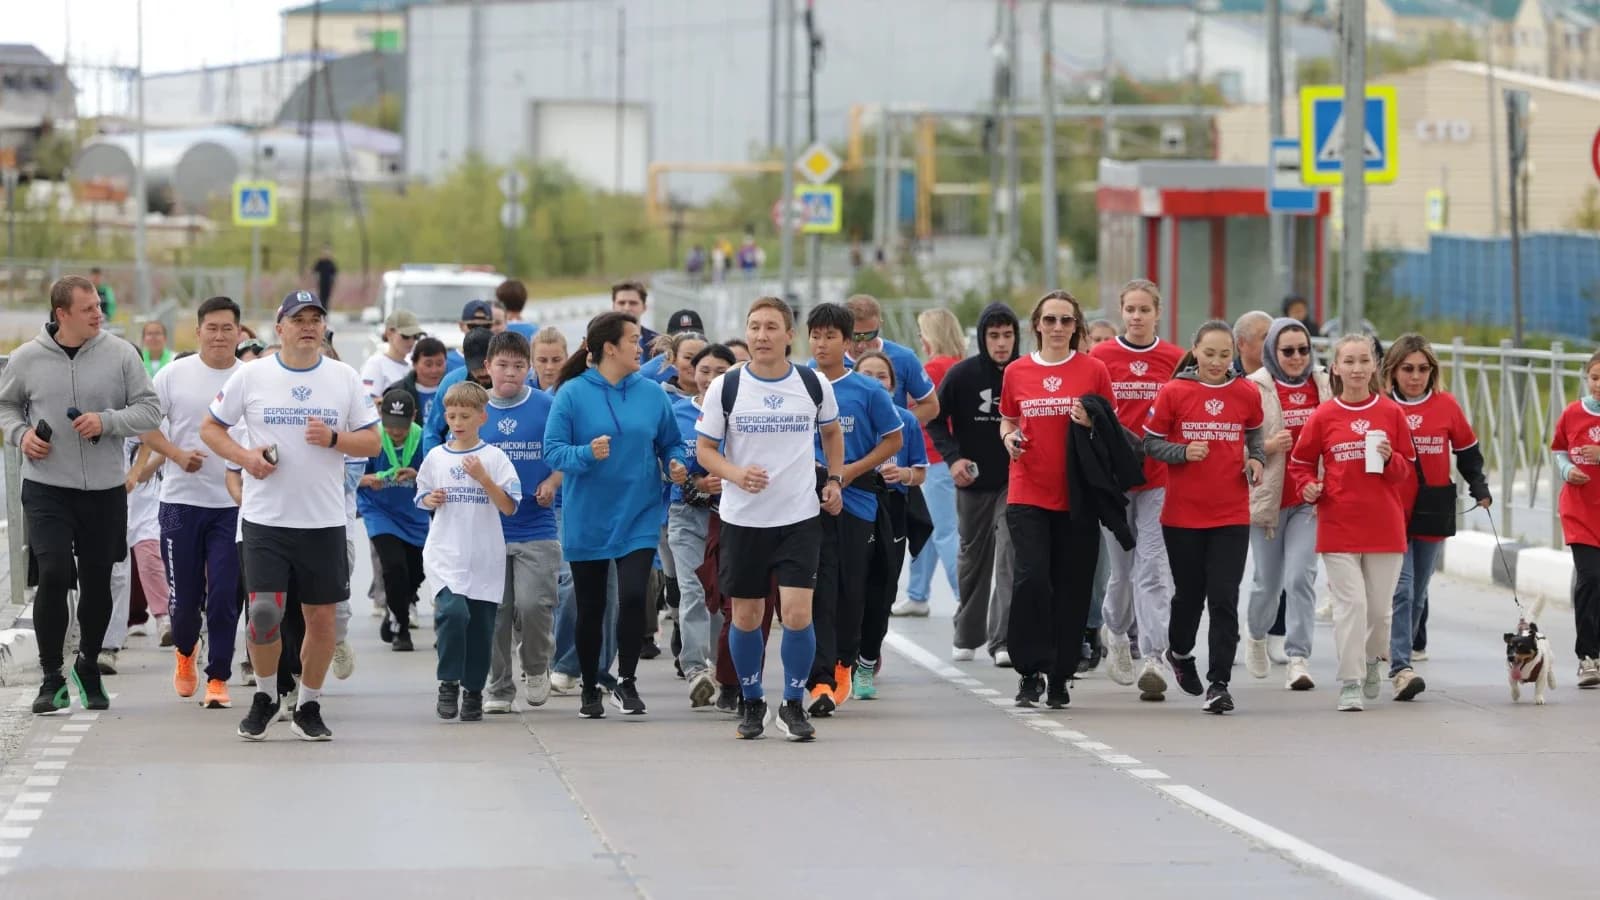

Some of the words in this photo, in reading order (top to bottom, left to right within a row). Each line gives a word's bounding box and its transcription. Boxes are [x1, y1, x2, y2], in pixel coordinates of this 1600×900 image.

[1416, 119, 1472, 140] СТО
[263, 407, 321, 417] ВСЕРОССИЙСКИЙ
[323, 408, 338, 416] ДЕНЬ
[736, 414, 794, 424] ВСЕРОССИЙСКИЙ
[736, 424, 809, 433] ФИЗКУЛЬТУРНИКА
